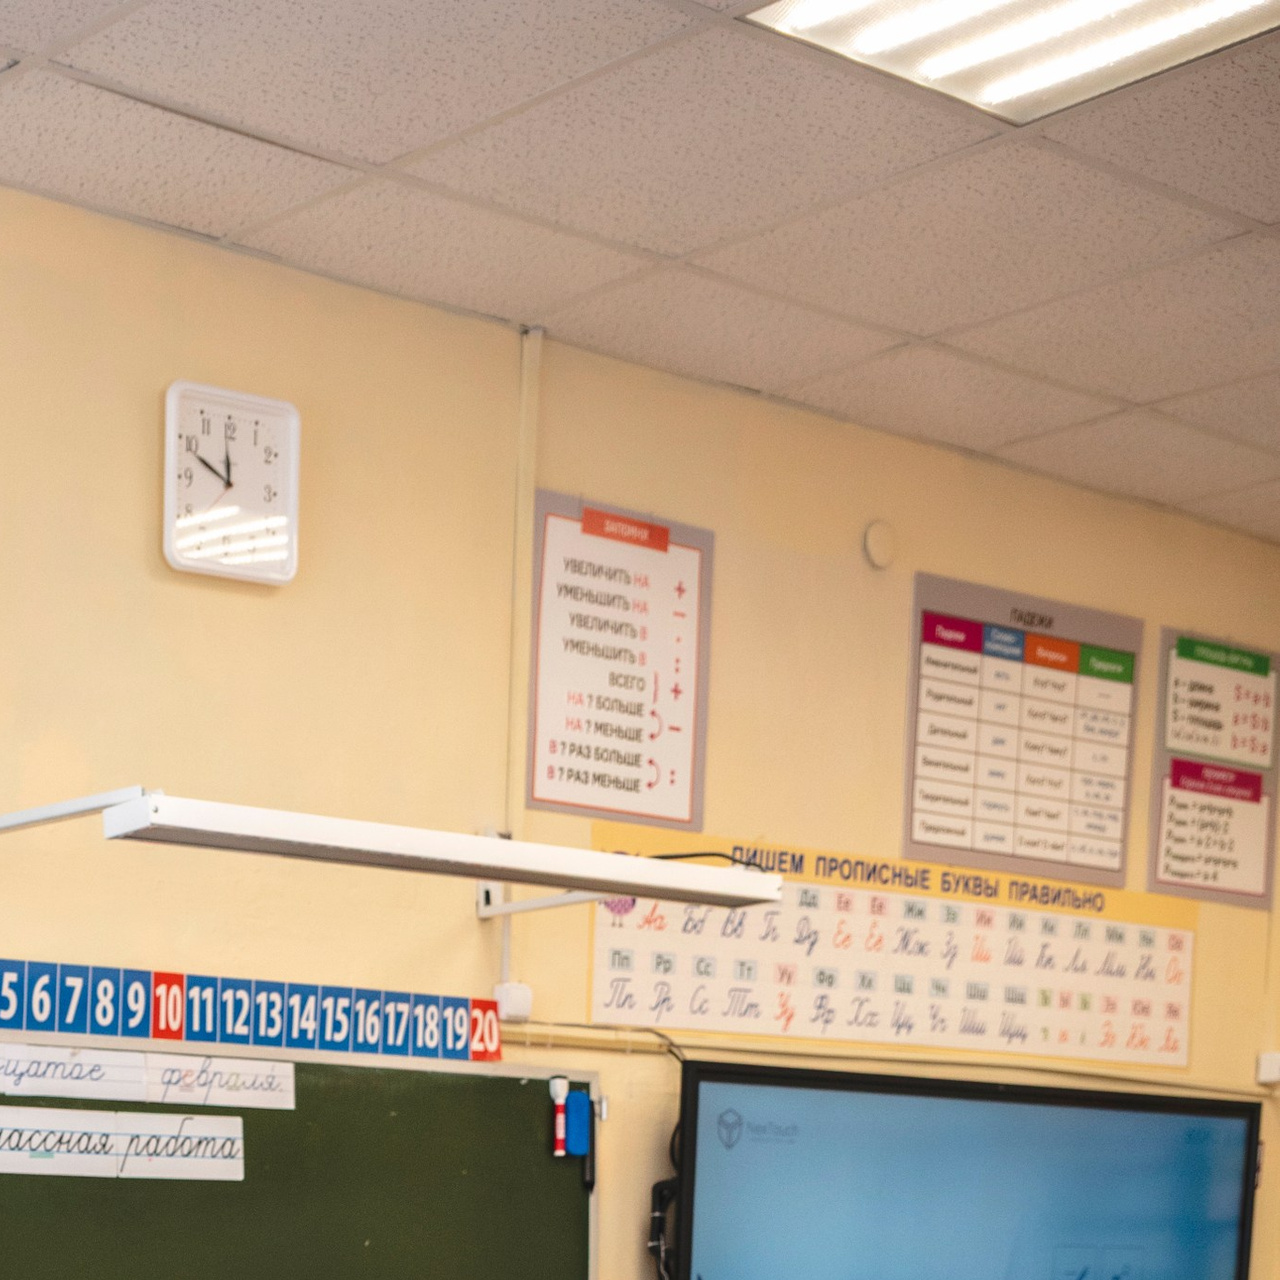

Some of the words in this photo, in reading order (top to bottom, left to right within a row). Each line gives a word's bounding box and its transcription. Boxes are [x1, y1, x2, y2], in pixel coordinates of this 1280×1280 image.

[202, 418, 210, 435] 11
[186, 435, 199, 454] 10
[184, 468, 193, 488] 9
[264, 485, 272, 503] 3
[563, 557, 631, 585] УВЕЛИЧИТЬ
[633, 567, 649, 589] НА
[556, 583, 630, 612] УМЕНЬШИТЬ
[632, 593, 649, 615] НА
[569, 612, 637, 640] УВЕЛИЧИТЬ
[639, 626, 648, 642] В
[563, 638, 637, 666] УМЕНЬШИТЬ
[638, 651, 648, 667] В
[608, 671, 646, 692] ВСЕГО
[567, 692, 585, 708] НА
[596, 697, 645, 718] БОЛЬШЕ
[565, 717, 583, 733] НА
[593, 722, 644, 744] МЕНЬШЕ
[549, 739, 558, 754] В
[568, 743, 592, 760] РАЗ
[593, 747, 642, 768] БОЛЬШЕ
[547, 765, 556, 780] В
[567, 769, 589, 786] РАЗ
[591, 772, 641, 793] МЕНЬШЕ
[731, 845, 804, 874] ПИШЕМ
[815, 856, 931, 890] ПРОПИСНЫЕ
[941, 872, 999, 898] БУКВЫ
[1008, 880, 1105, 913] ПРАВИЛЬНО
[31, 974, 51, 1023] 6
[65, 976, 83, 1024] 7
[95, 978, 115, 1027] 8
[127, 981, 146, 1028] 9
[155, 983, 182, 1032] 10
[188, 986, 214, 1034] 11
[222, 989, 250, 1036] 12
[255, 991, 282, 1038] 13
[288, 994, 316, 1040] 14
[322, 997, 351, 1042] 15
[355, 999, 380, 1044] 16
[385, 1001, 410, 1046] 17
[413, 1004, 440, 1048] 18
[443, 1006, 469, 1050] 19
[471, 1008, 499, 1052] 20
[121, 1116, 241, 1173] работа
